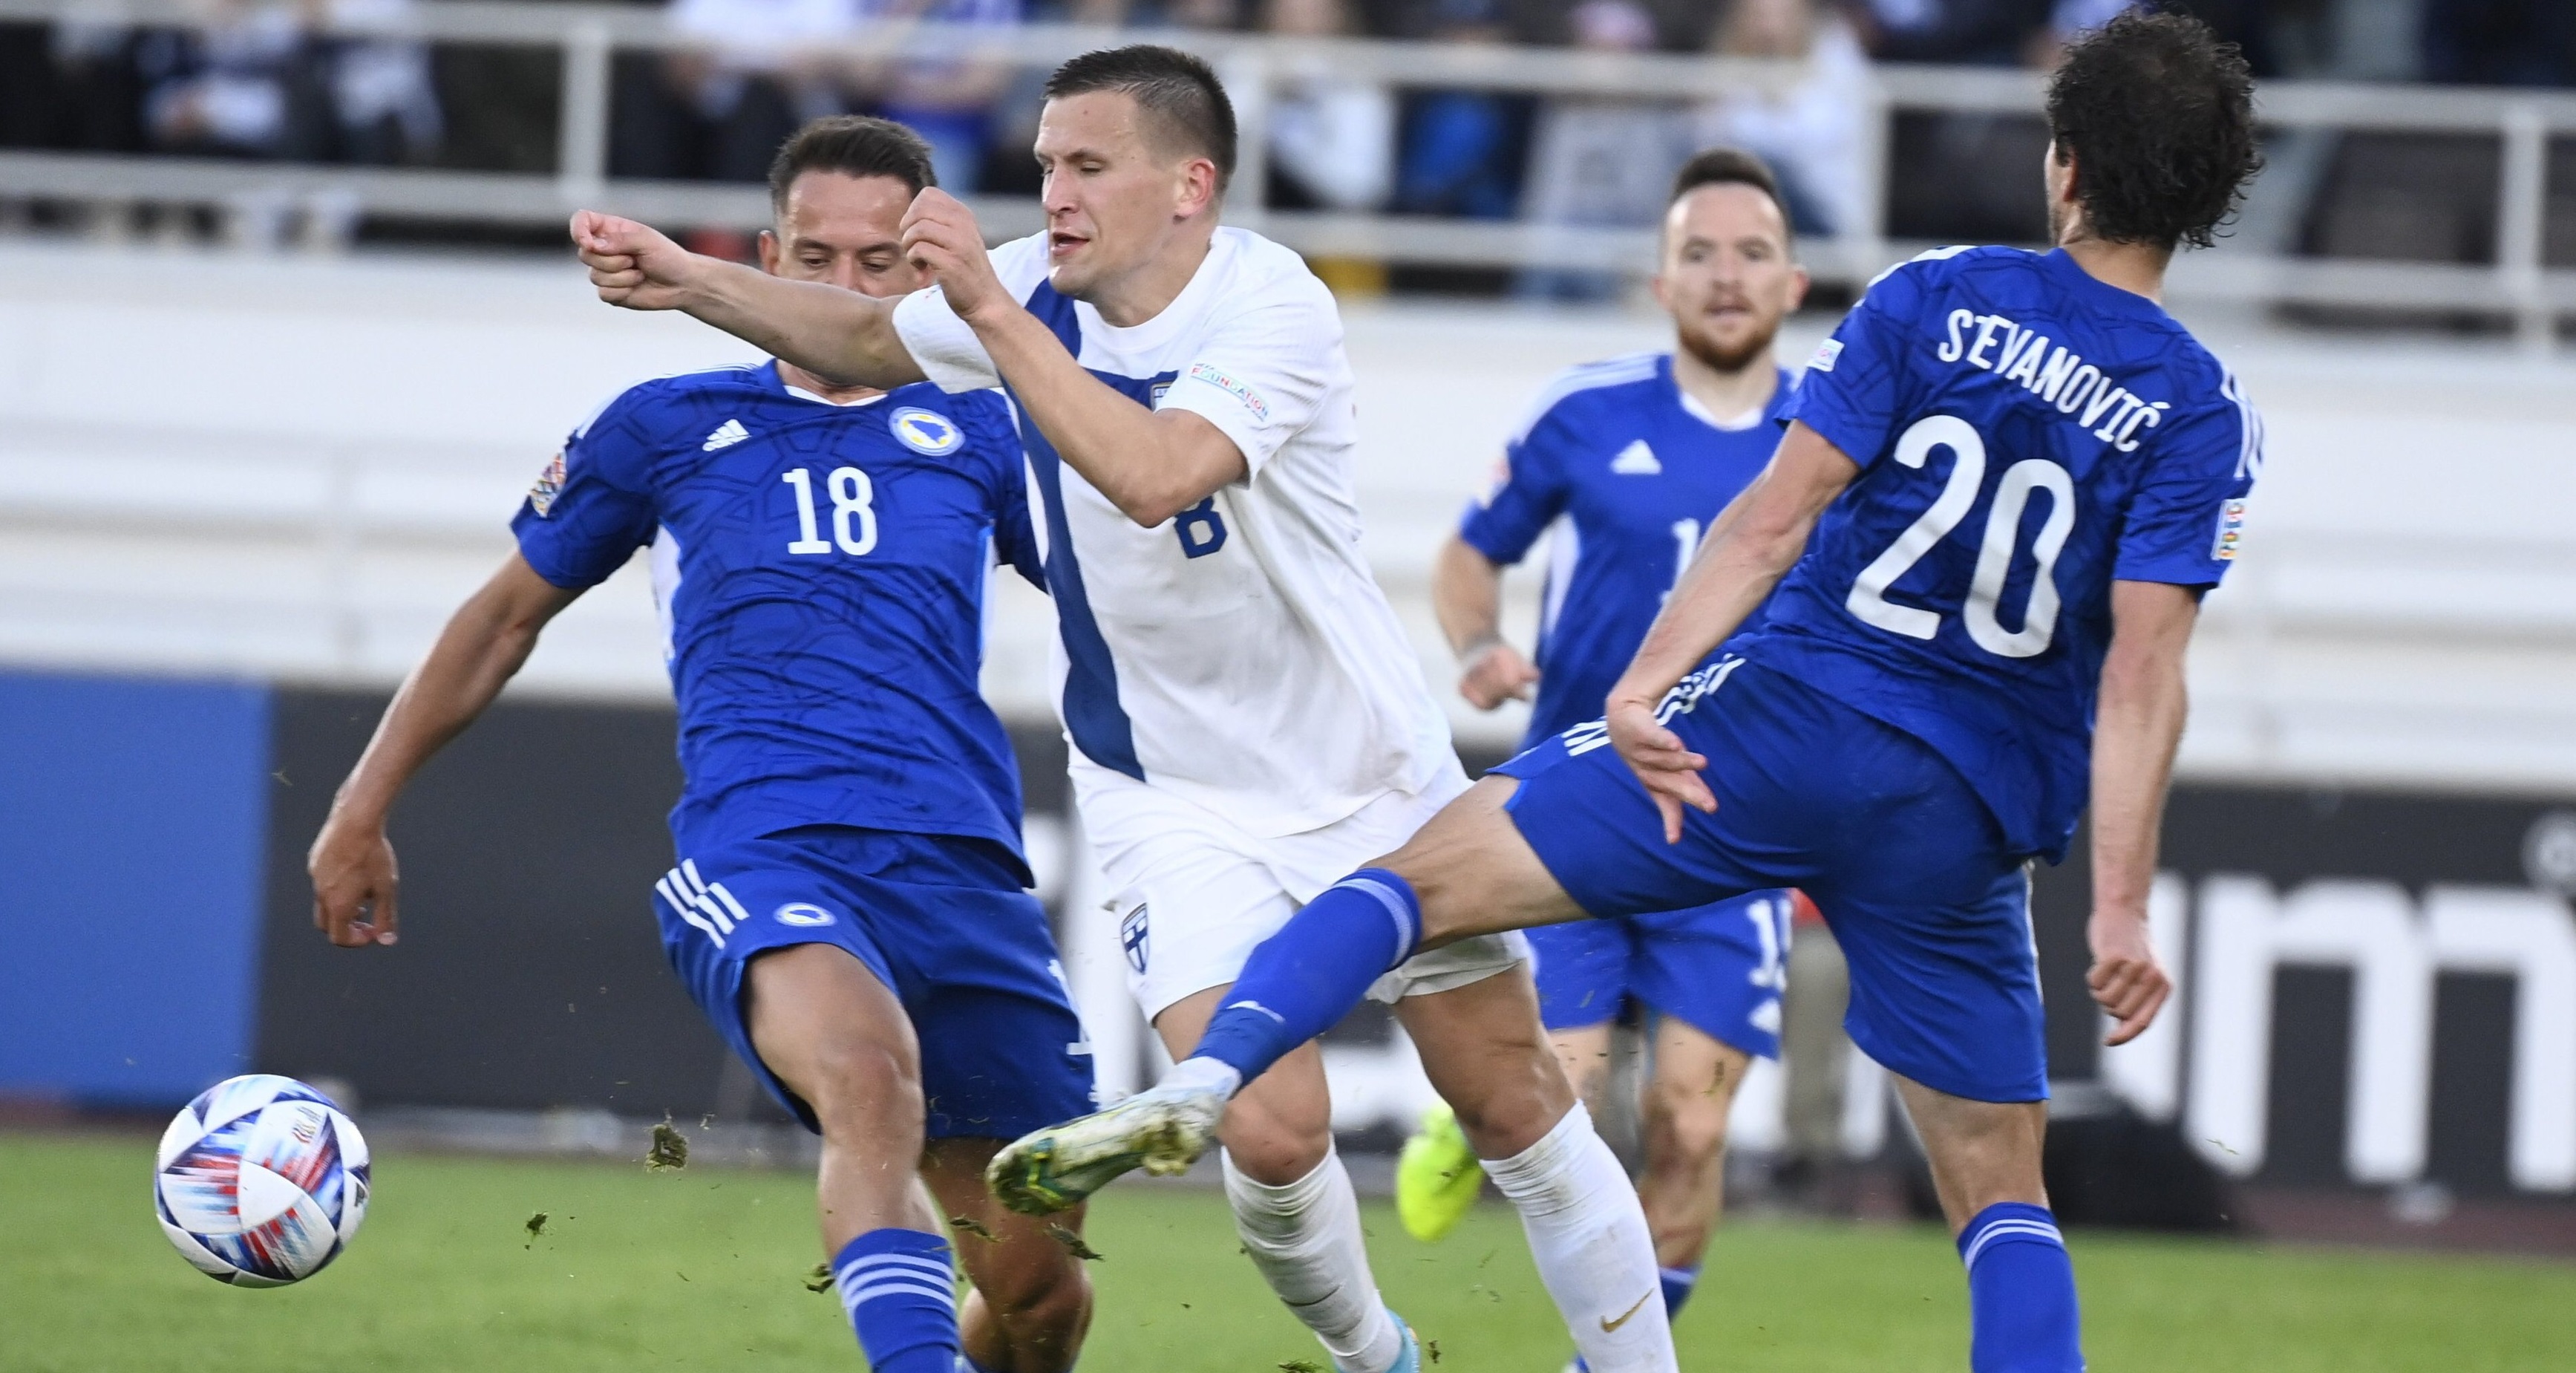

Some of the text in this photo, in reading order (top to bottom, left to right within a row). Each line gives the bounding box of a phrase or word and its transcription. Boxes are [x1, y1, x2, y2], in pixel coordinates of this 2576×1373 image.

[1191, 366, 1269, 417] FOUNDATION
[782, 466, 877, 555] 18
[1174, 495, 1228, 558] 8
[1845, 414, 2076, 658] 20
